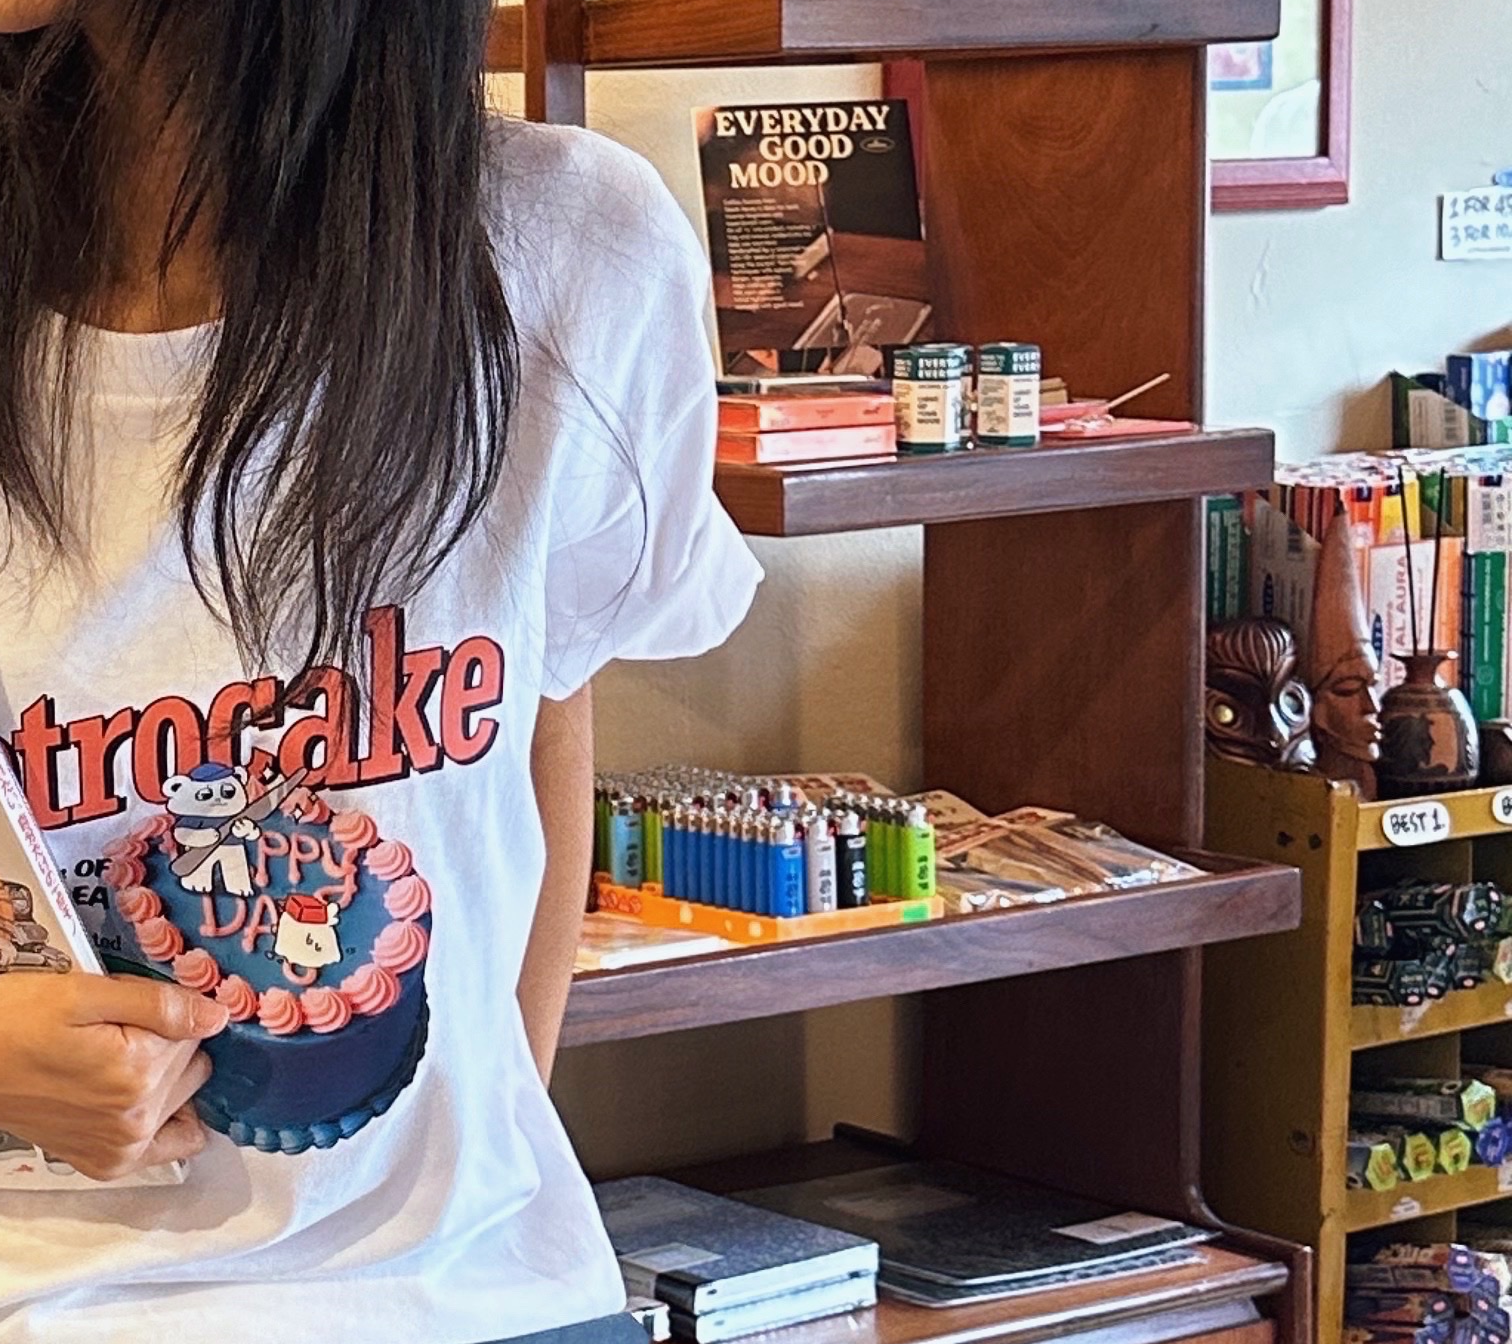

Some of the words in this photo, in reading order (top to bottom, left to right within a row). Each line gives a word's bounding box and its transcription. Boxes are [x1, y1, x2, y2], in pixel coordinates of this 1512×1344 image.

[714, 105, 890, 138] EVERYDAY
[759, 134, 854, 161] GOOD
[729, 161, 829, 189] MOOD
[1390, 812, 1427, 834] BEST
[251, 830, 359, 908] PPY
[200, 892, 310, 968] DA
